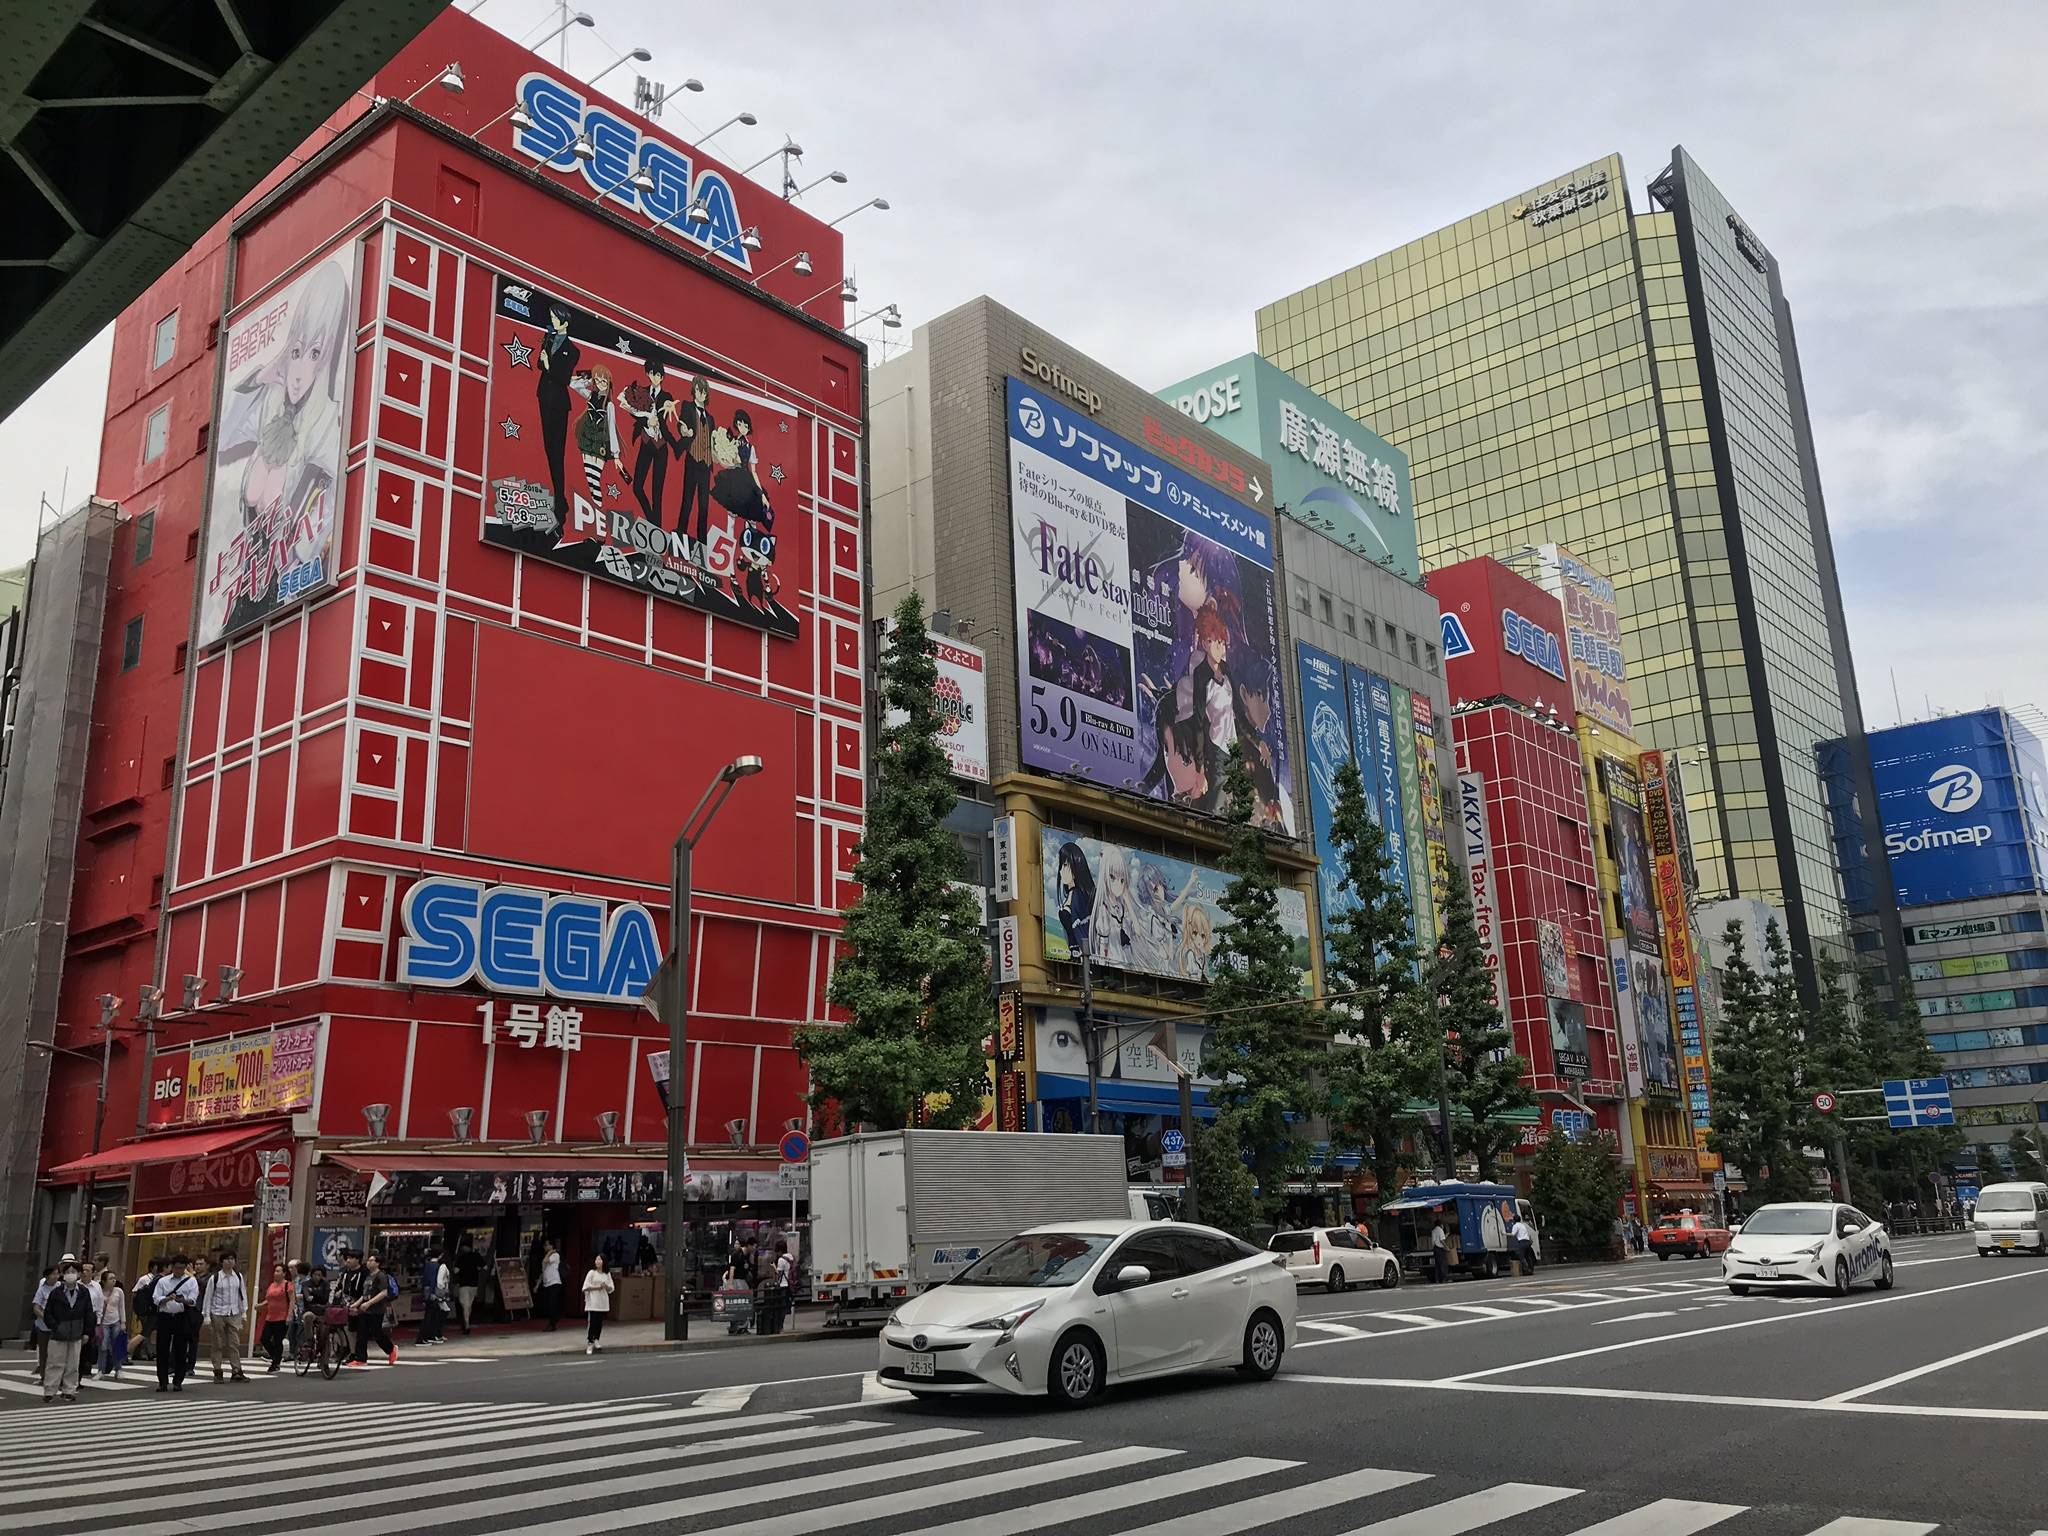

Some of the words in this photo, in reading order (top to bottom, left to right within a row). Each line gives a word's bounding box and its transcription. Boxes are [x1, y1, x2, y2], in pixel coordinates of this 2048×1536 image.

[513, 71, 752, 273] SEGA
[1532, 186, 1609, 225] 秋葉原ビル
[230, 325, 275, 373] BREAK
[231, 300, 288, 355] BORDER
[1022, 346, 1102, 416] Sofmap
[1053, 417, 1162, 495] ソフマップ
[1143, 415, 1246, 493] ビックカメラ
[1279, 399, 1401, 516] 廣瀬無線
[276, 555, 324, 603] SEGA
[602, 547, 697, 598] キャンペーン
[665, 556, 718, 589] Animation
[1037, 519, 1099, 595] Fate
[1102, 577, 1132, 615] stay
[1132, 587, 1172, 628] night
[1313, 658, 1330, 675] Hey
[1502, 608, 1567, 682] SEGA
[933, 695, 974, 724] APPLE
[1030, 685, 1077, 742] 5.9
[1085, 713, 1108, 731] Blu-ray
[1116, 724, 1132, 737] DVD
[1081, 731, 1099, 753] ON
[1102, 737, 1135, 764] SALE
[1377, 718, 1407, 899] 電子マネー使えま
[1460, 779, 1483, 841] AKKY
[1885, 825, 1992, 855] Sofmap
[1471, 858, 1493, 951] Tax-free
[396, 876, 665, 1006] SEGA
[1003, 929, 1014, 968] GPS
[1481, 952, 1500, 1008] Shop
[1613, 957, 1628, 993] SEGA
[476, 1001, 584, 1052] 1号館
[1003, 1050, 1014, 1060] 1F
[154, 1077, 182, 1101] BIG
[1818, 1098, 1832, 1107] 50
[1164, 1136, 1181, 1146] 437
[327, 1236, 347, 1264] 25
[911, 1362, 932, 1375] 25-35
